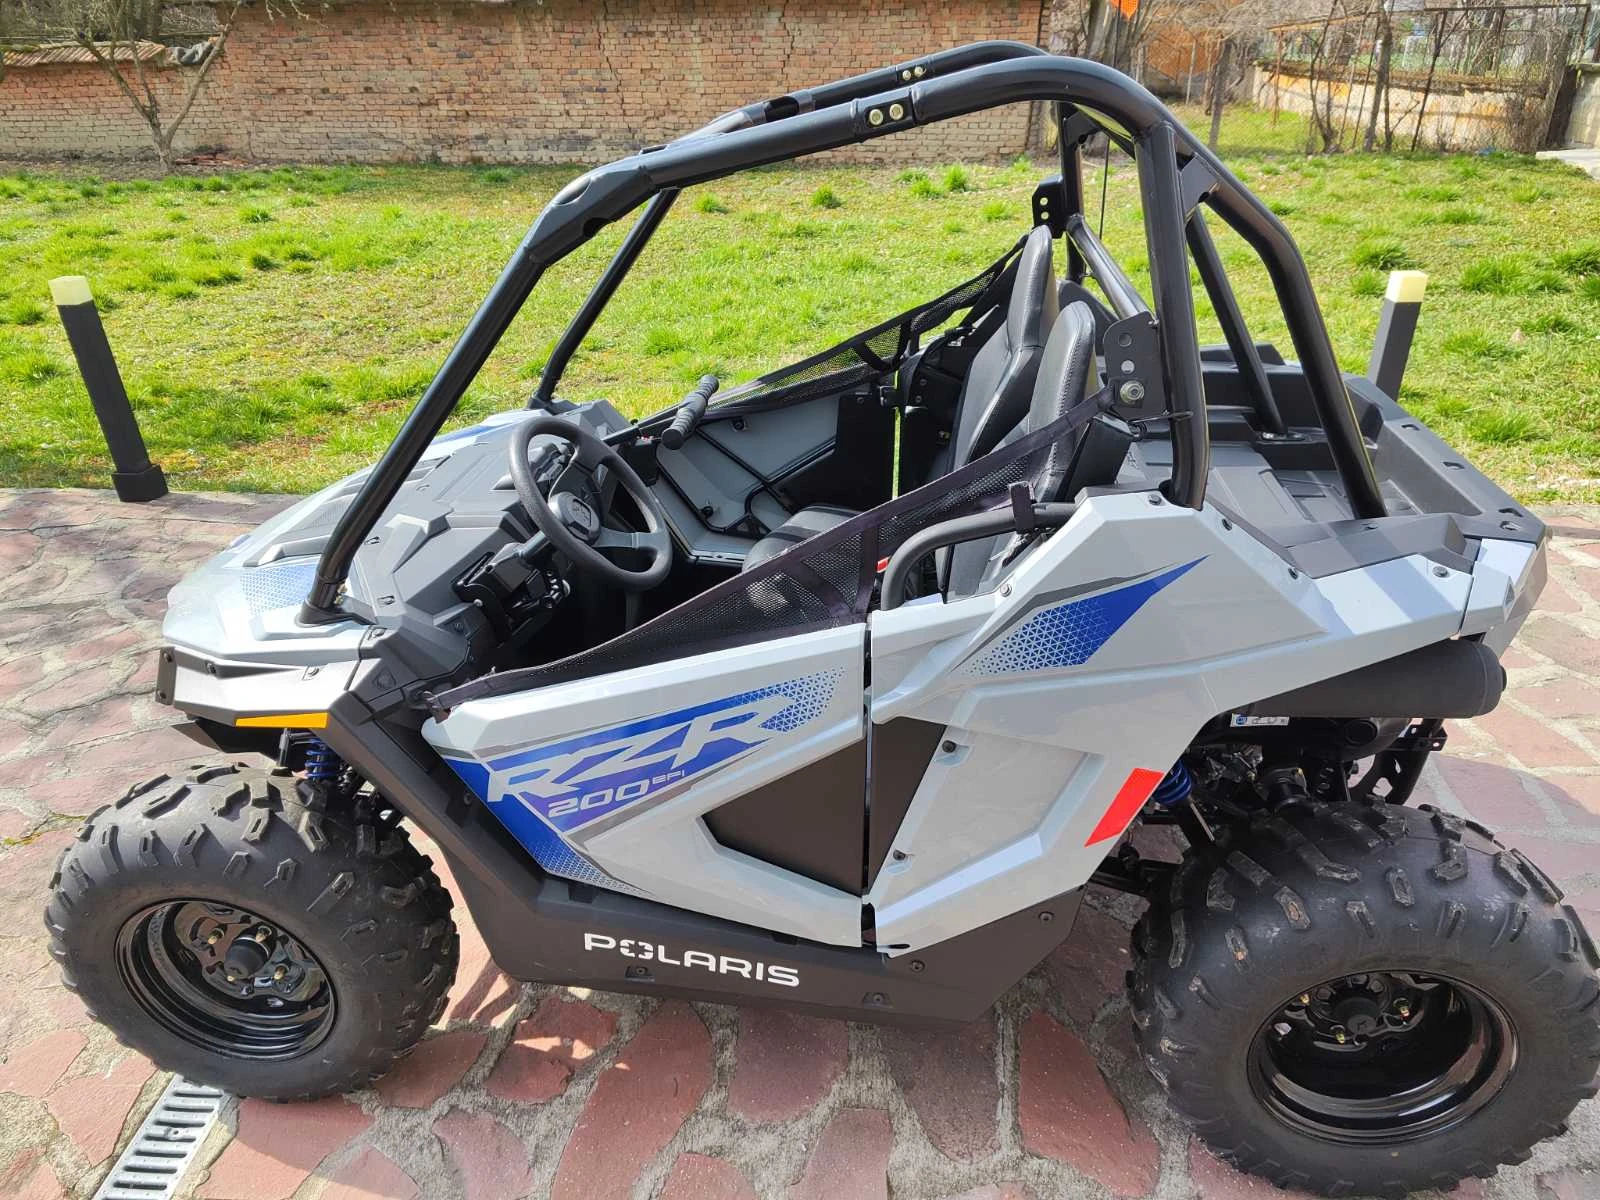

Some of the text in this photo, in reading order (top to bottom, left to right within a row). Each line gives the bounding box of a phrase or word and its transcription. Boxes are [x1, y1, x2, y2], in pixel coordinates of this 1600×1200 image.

[487, 693, 796, 802] RZR
[548, 778, 650, 817] 200
[584, 932, 800, 988] POLARIS
